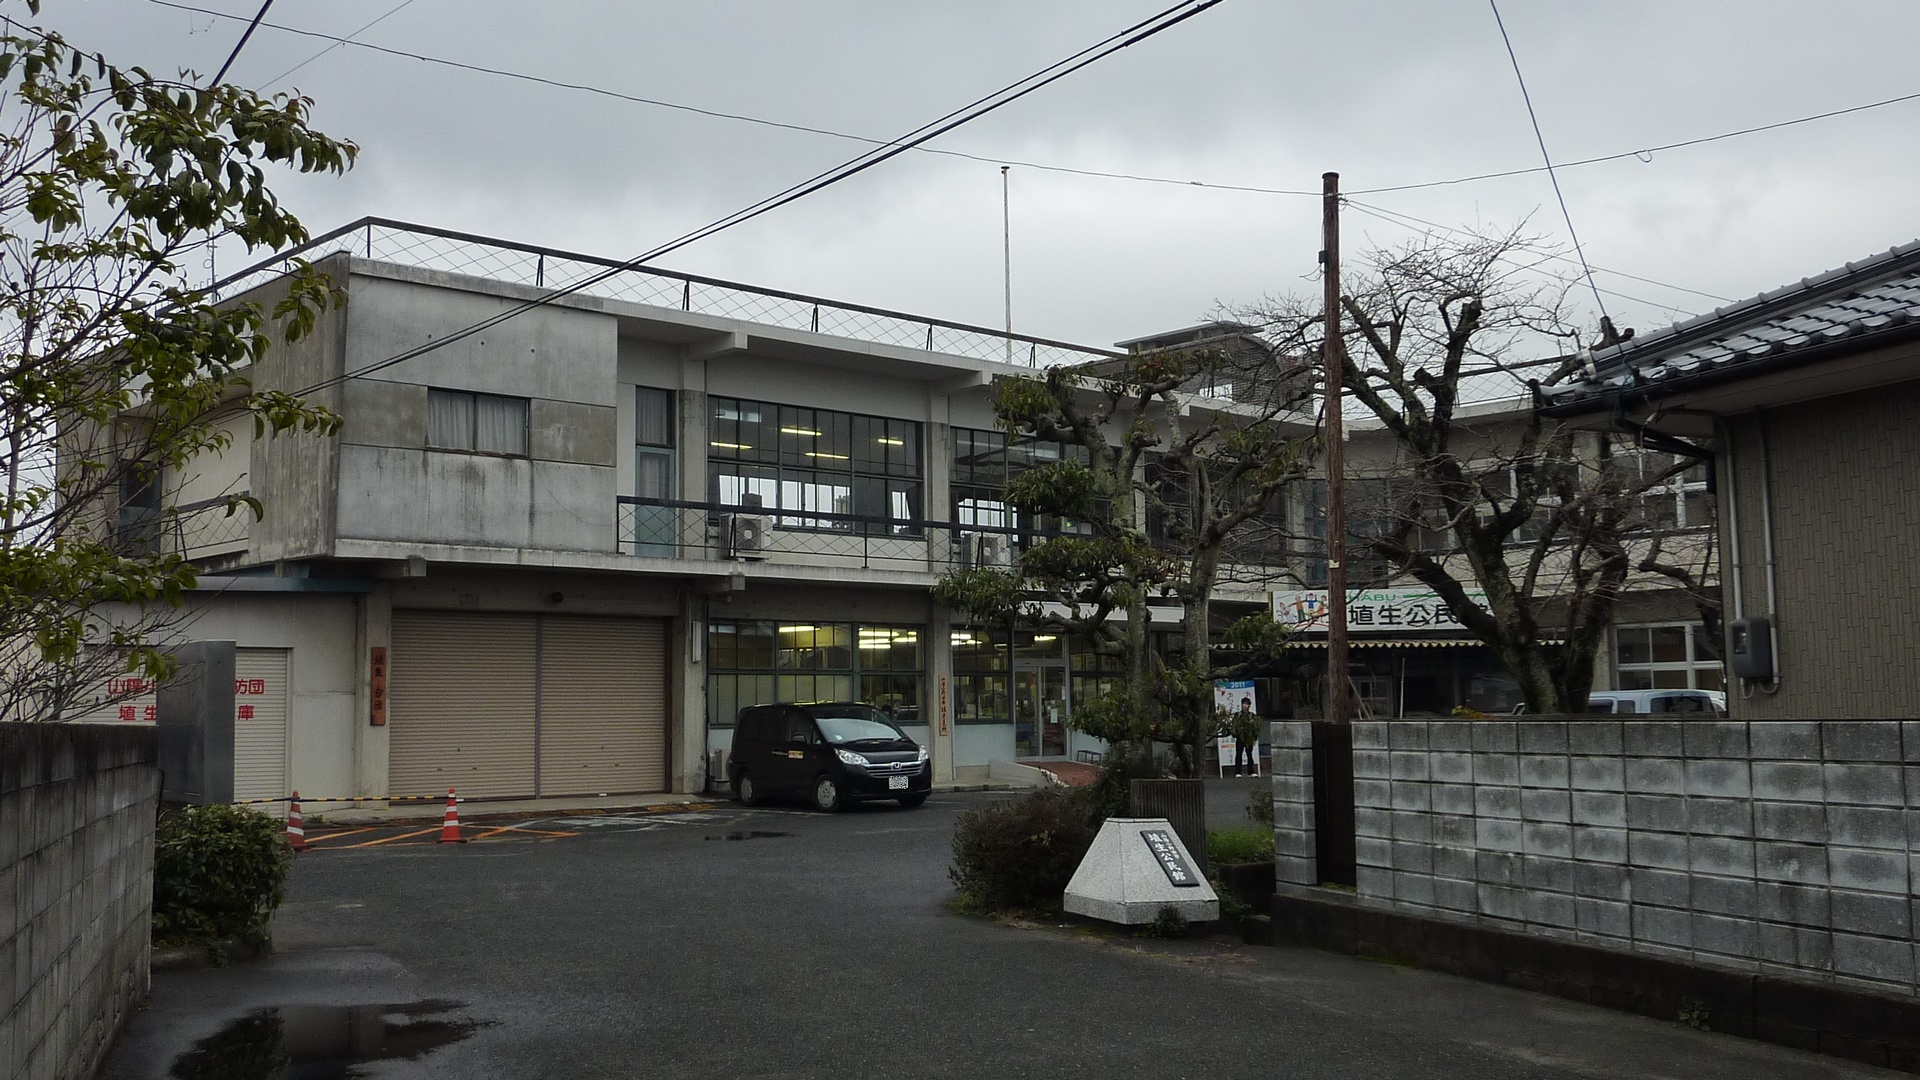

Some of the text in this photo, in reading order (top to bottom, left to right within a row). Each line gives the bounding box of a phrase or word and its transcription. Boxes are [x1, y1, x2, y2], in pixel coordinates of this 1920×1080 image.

[1348, 604, 1487, 625] 埴生公民
[1230, 681, 1246, 689] 2011
[1148, 833, 1187, 881] 埴生公民館
